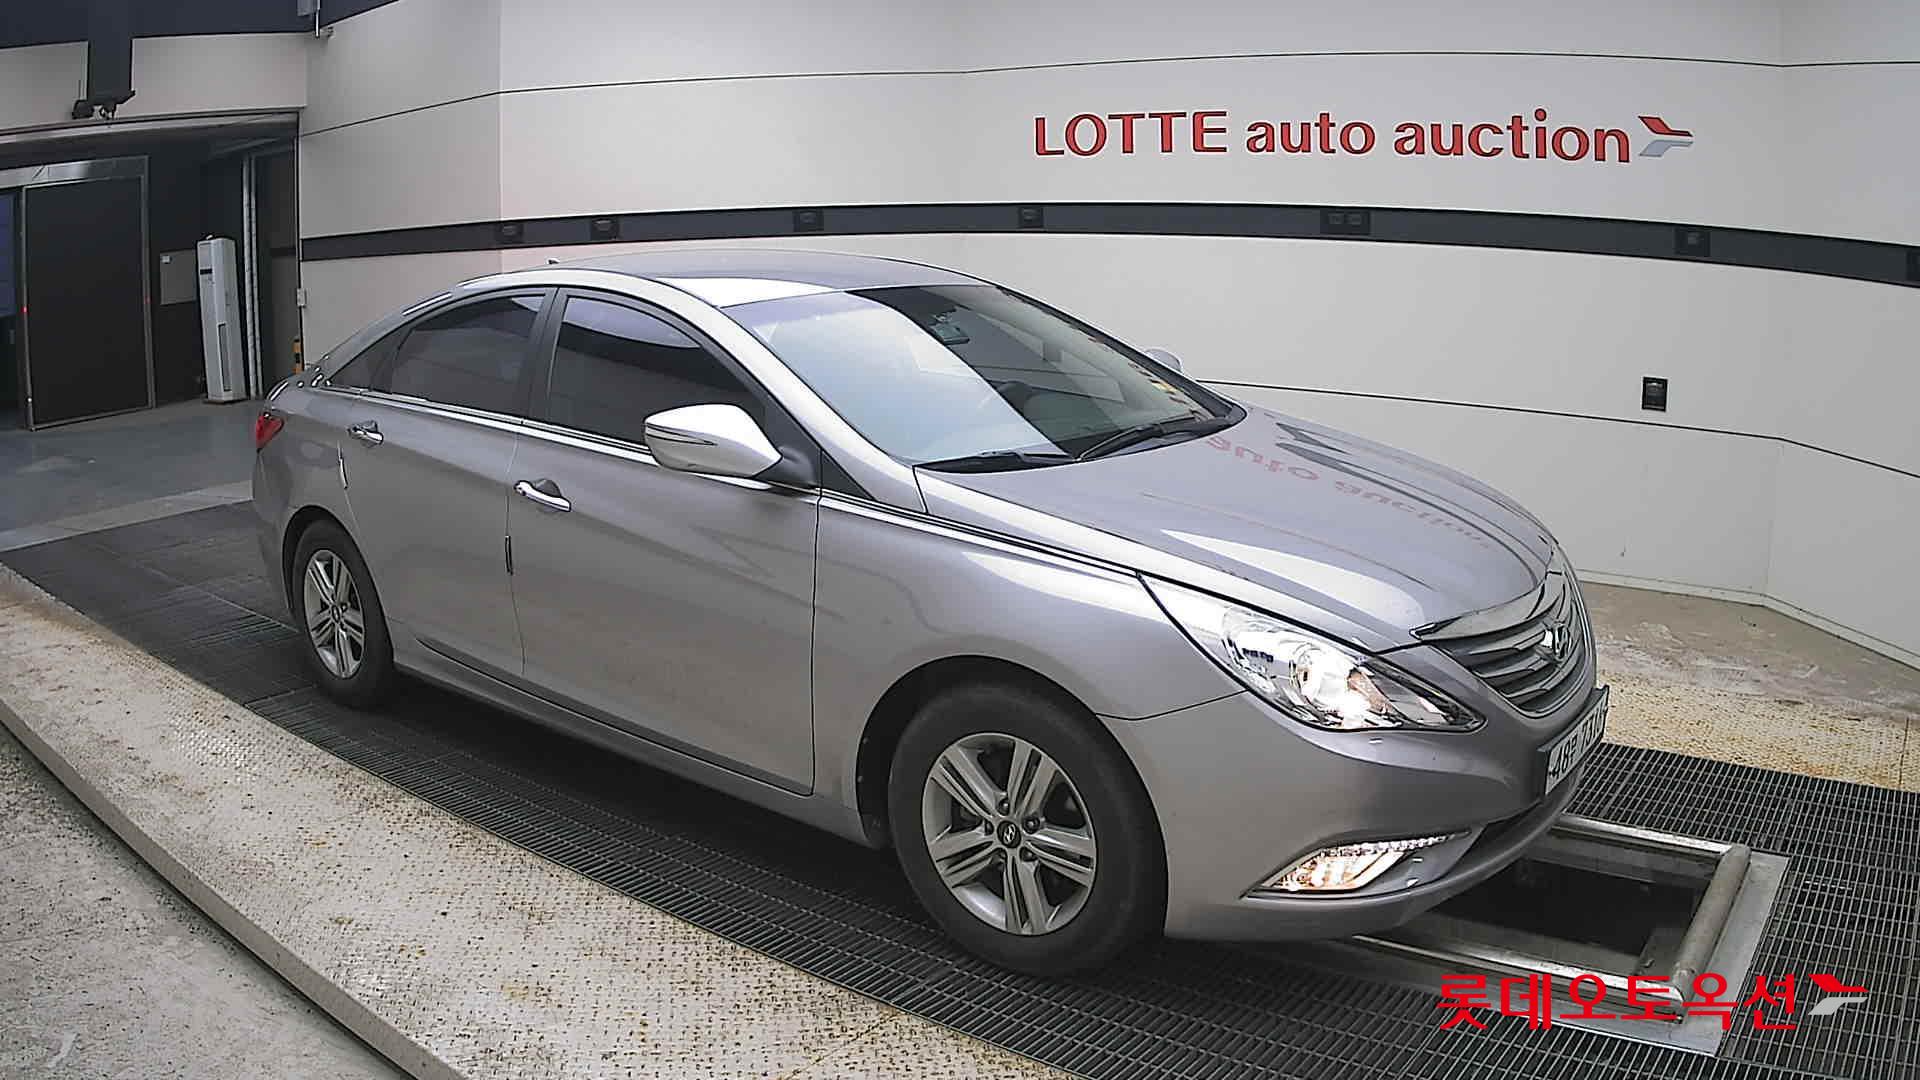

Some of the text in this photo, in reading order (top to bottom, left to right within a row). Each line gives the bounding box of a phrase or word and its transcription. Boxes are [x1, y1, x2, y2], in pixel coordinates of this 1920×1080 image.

[1035, 108, 1630, 163] LOTTE auto auction
